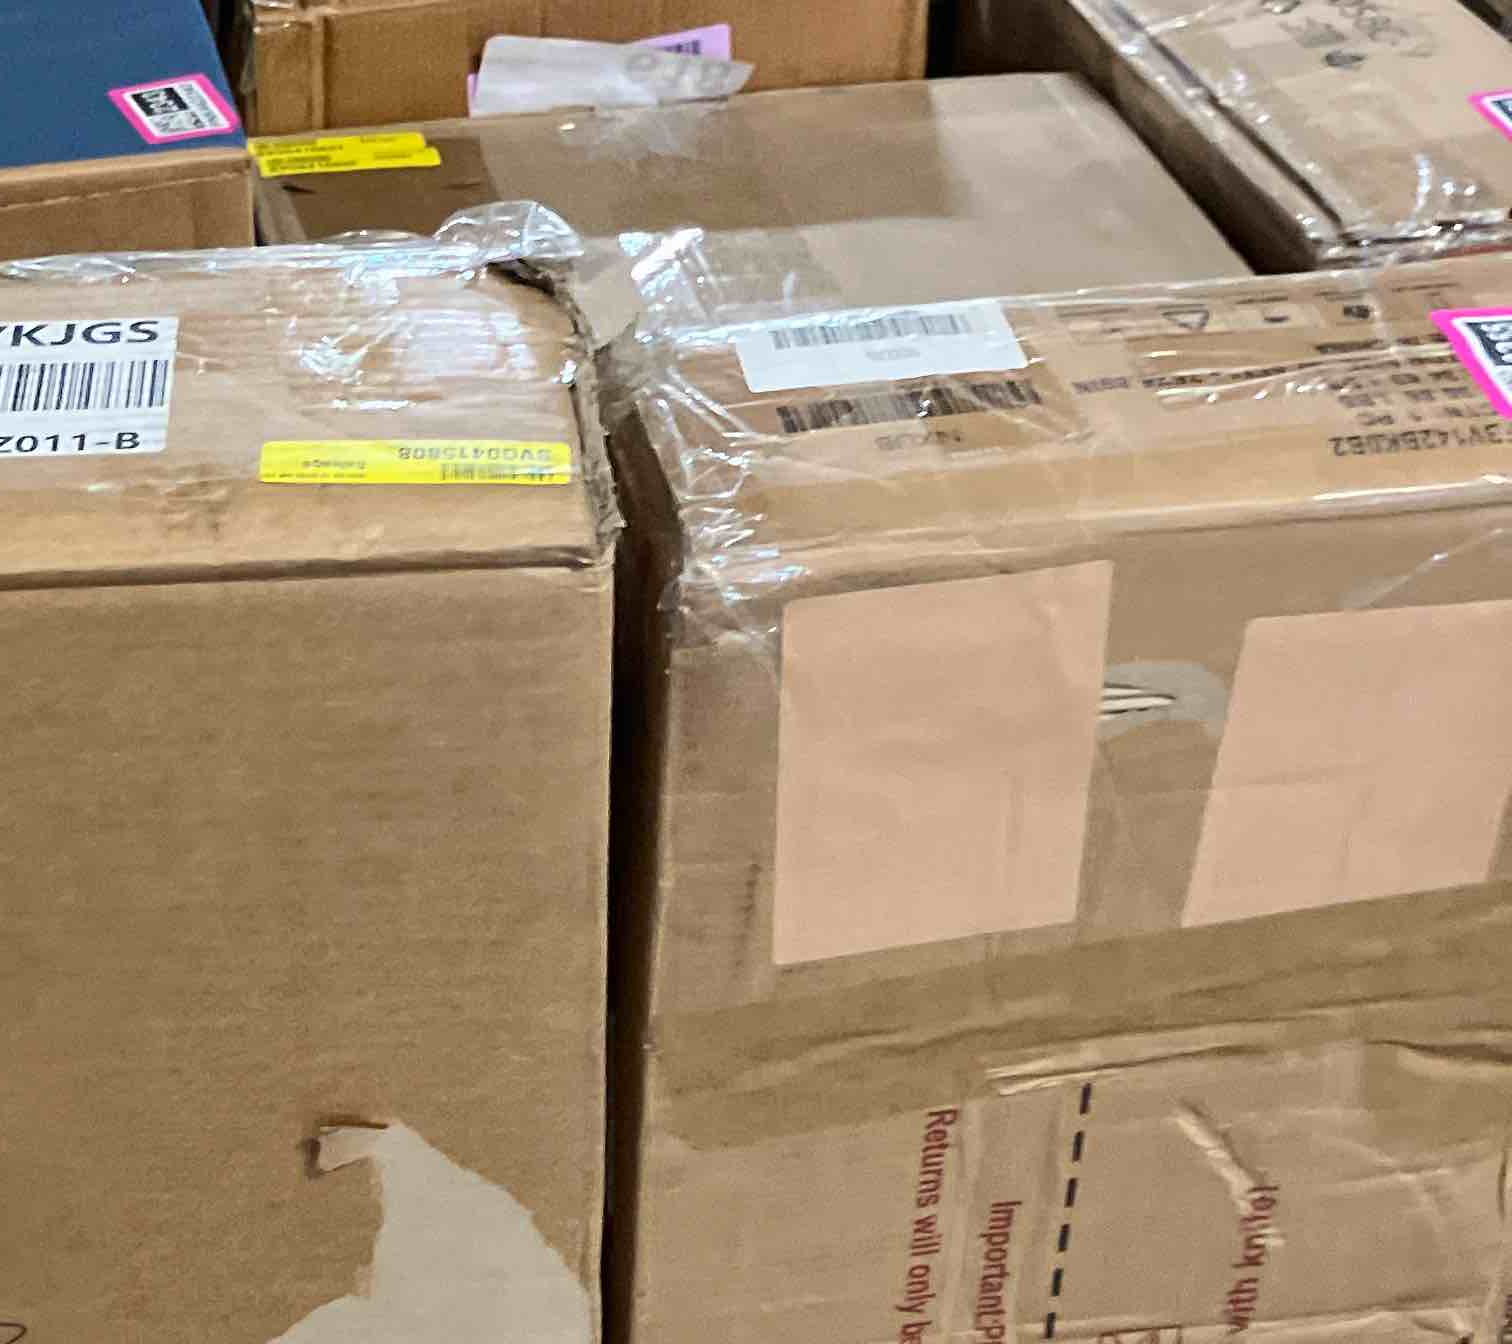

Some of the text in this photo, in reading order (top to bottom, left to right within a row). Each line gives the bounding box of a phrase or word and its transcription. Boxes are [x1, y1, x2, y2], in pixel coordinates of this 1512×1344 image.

[915, 1108, 960, 1209] Returns
[910, 1213, 943, 1257] will
[895, 1263, 937, 1314] only
[1225, 1276, 1260, 1333] with
